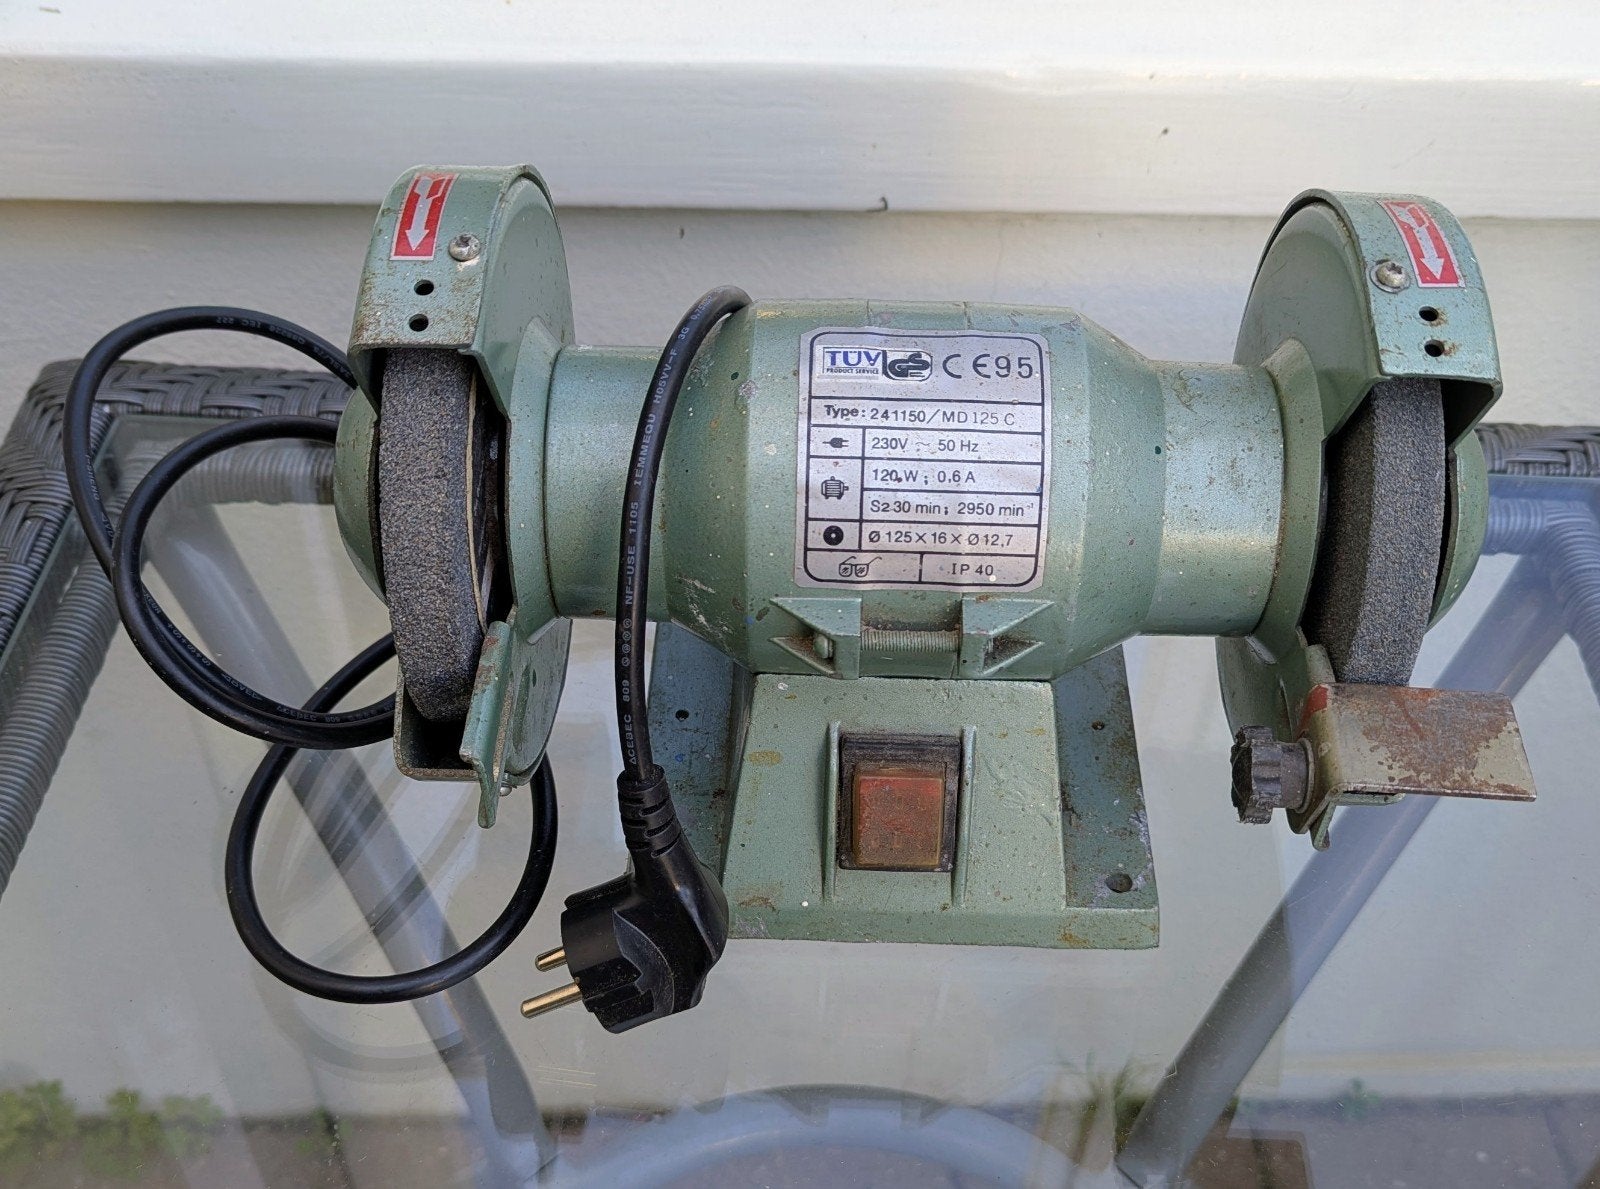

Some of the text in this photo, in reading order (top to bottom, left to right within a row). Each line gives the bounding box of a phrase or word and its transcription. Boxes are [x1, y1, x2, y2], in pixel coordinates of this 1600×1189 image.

[677, 325, 691, 341] 3G
[825, 350, 881, 366] TÜV
[824, 404, 866, 421] Type:
[872, 437, 908, 450] 230V
[937, 438, 956, 451] 50
[960, 440, 979, 453] Hz
[872, 468, 898, 482] 120
[965, 471, 976, 484] A
[957, 502, 995, 516] 2950
[628, 501, 639, 534] 1105
[623, 545, 637, 605] NF-USE
[951, 563, 994, 577] IP 40
